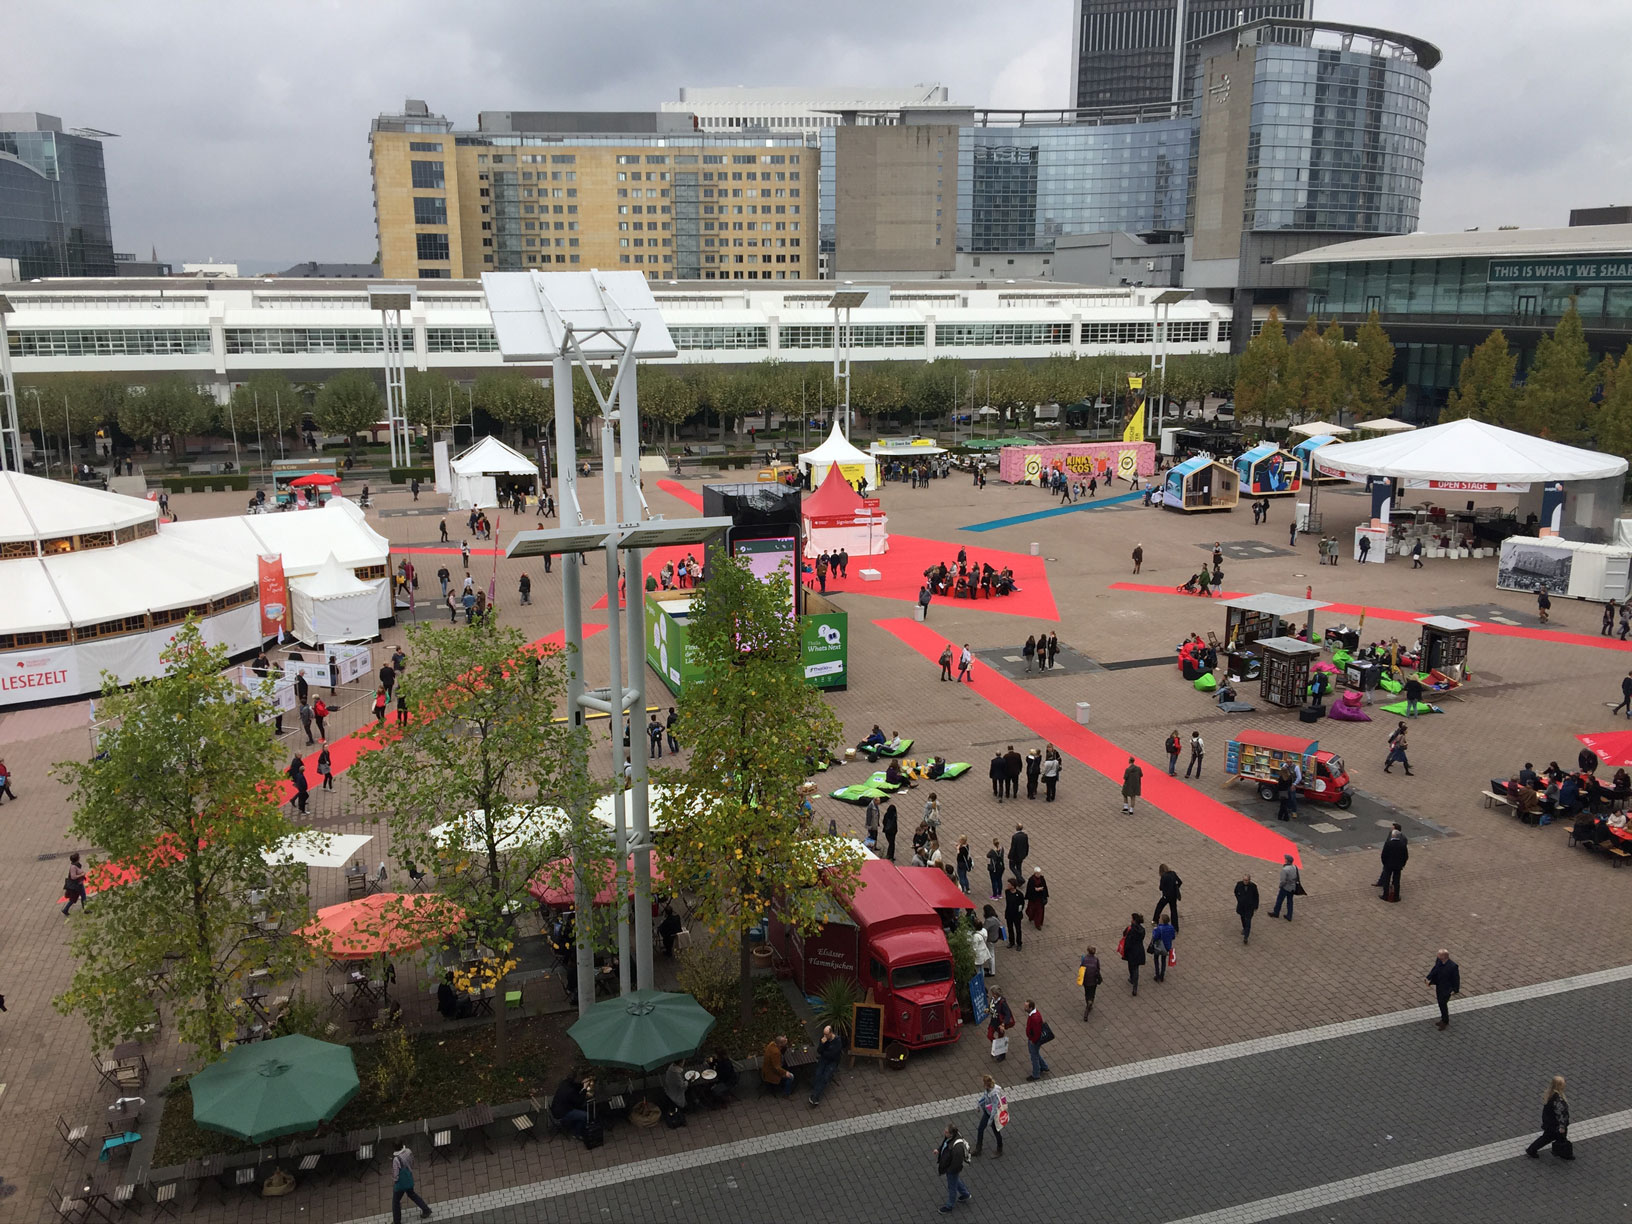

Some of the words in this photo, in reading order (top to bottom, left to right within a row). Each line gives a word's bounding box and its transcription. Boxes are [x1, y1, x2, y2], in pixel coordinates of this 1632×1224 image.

[1494, 266, 1519, 277] THIS
[1522, 265, 1533, 277] IS
[1535, 265, 1573, 277] WHAT
[1576, 264, 1597, 277] WE
[1066, 456, 1092, 466] KINKY
[1437, 481, 1460, 489] OPEN
[1462, 482, 1488, 490] STAGE
[1, 669, 68, 691] LESEZELT
[818, 948, 845, 958] Elsässer
[808, 957, 854, 971] Flammkuchen
